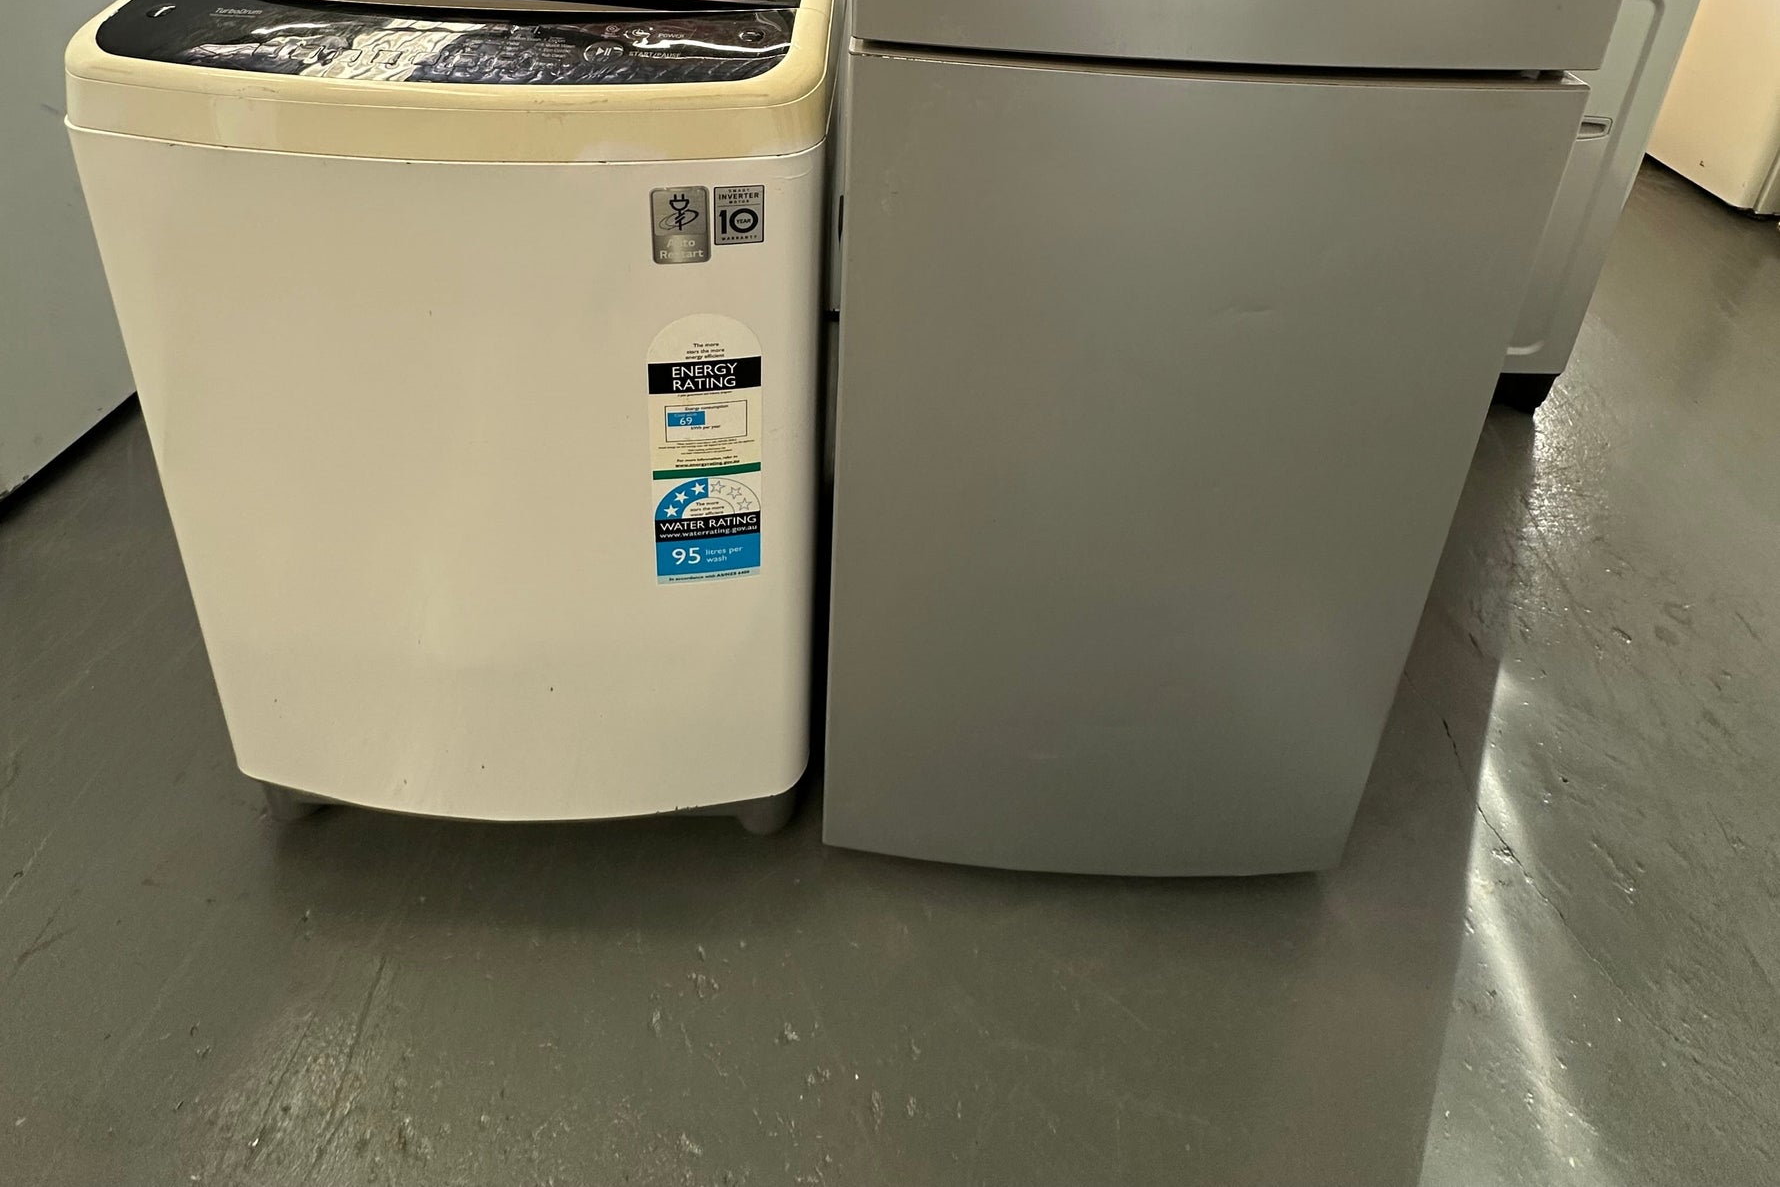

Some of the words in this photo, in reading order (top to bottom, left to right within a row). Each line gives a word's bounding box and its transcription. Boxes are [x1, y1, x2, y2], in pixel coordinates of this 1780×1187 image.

[718, 192, 760, 200] INVERTER
[719, 208, 758, 234] 10
[660, 249, 704, 260] Retart
[672, 362, 738, 378] ENERGY
[673, 376, 736, 391] RATING
[680, 416, 692, 426] 69
[660, 520, 704, 531] WATER
[709, 514, 756, 528] RATING
[660, 525, 758, 539] www.waterrating.gov.au
[672, 547, 701, 565] 95
[706, 548, 726, 556] litres
[729, 546, 743, 554] per
[706, 555, 727, 563] wash
